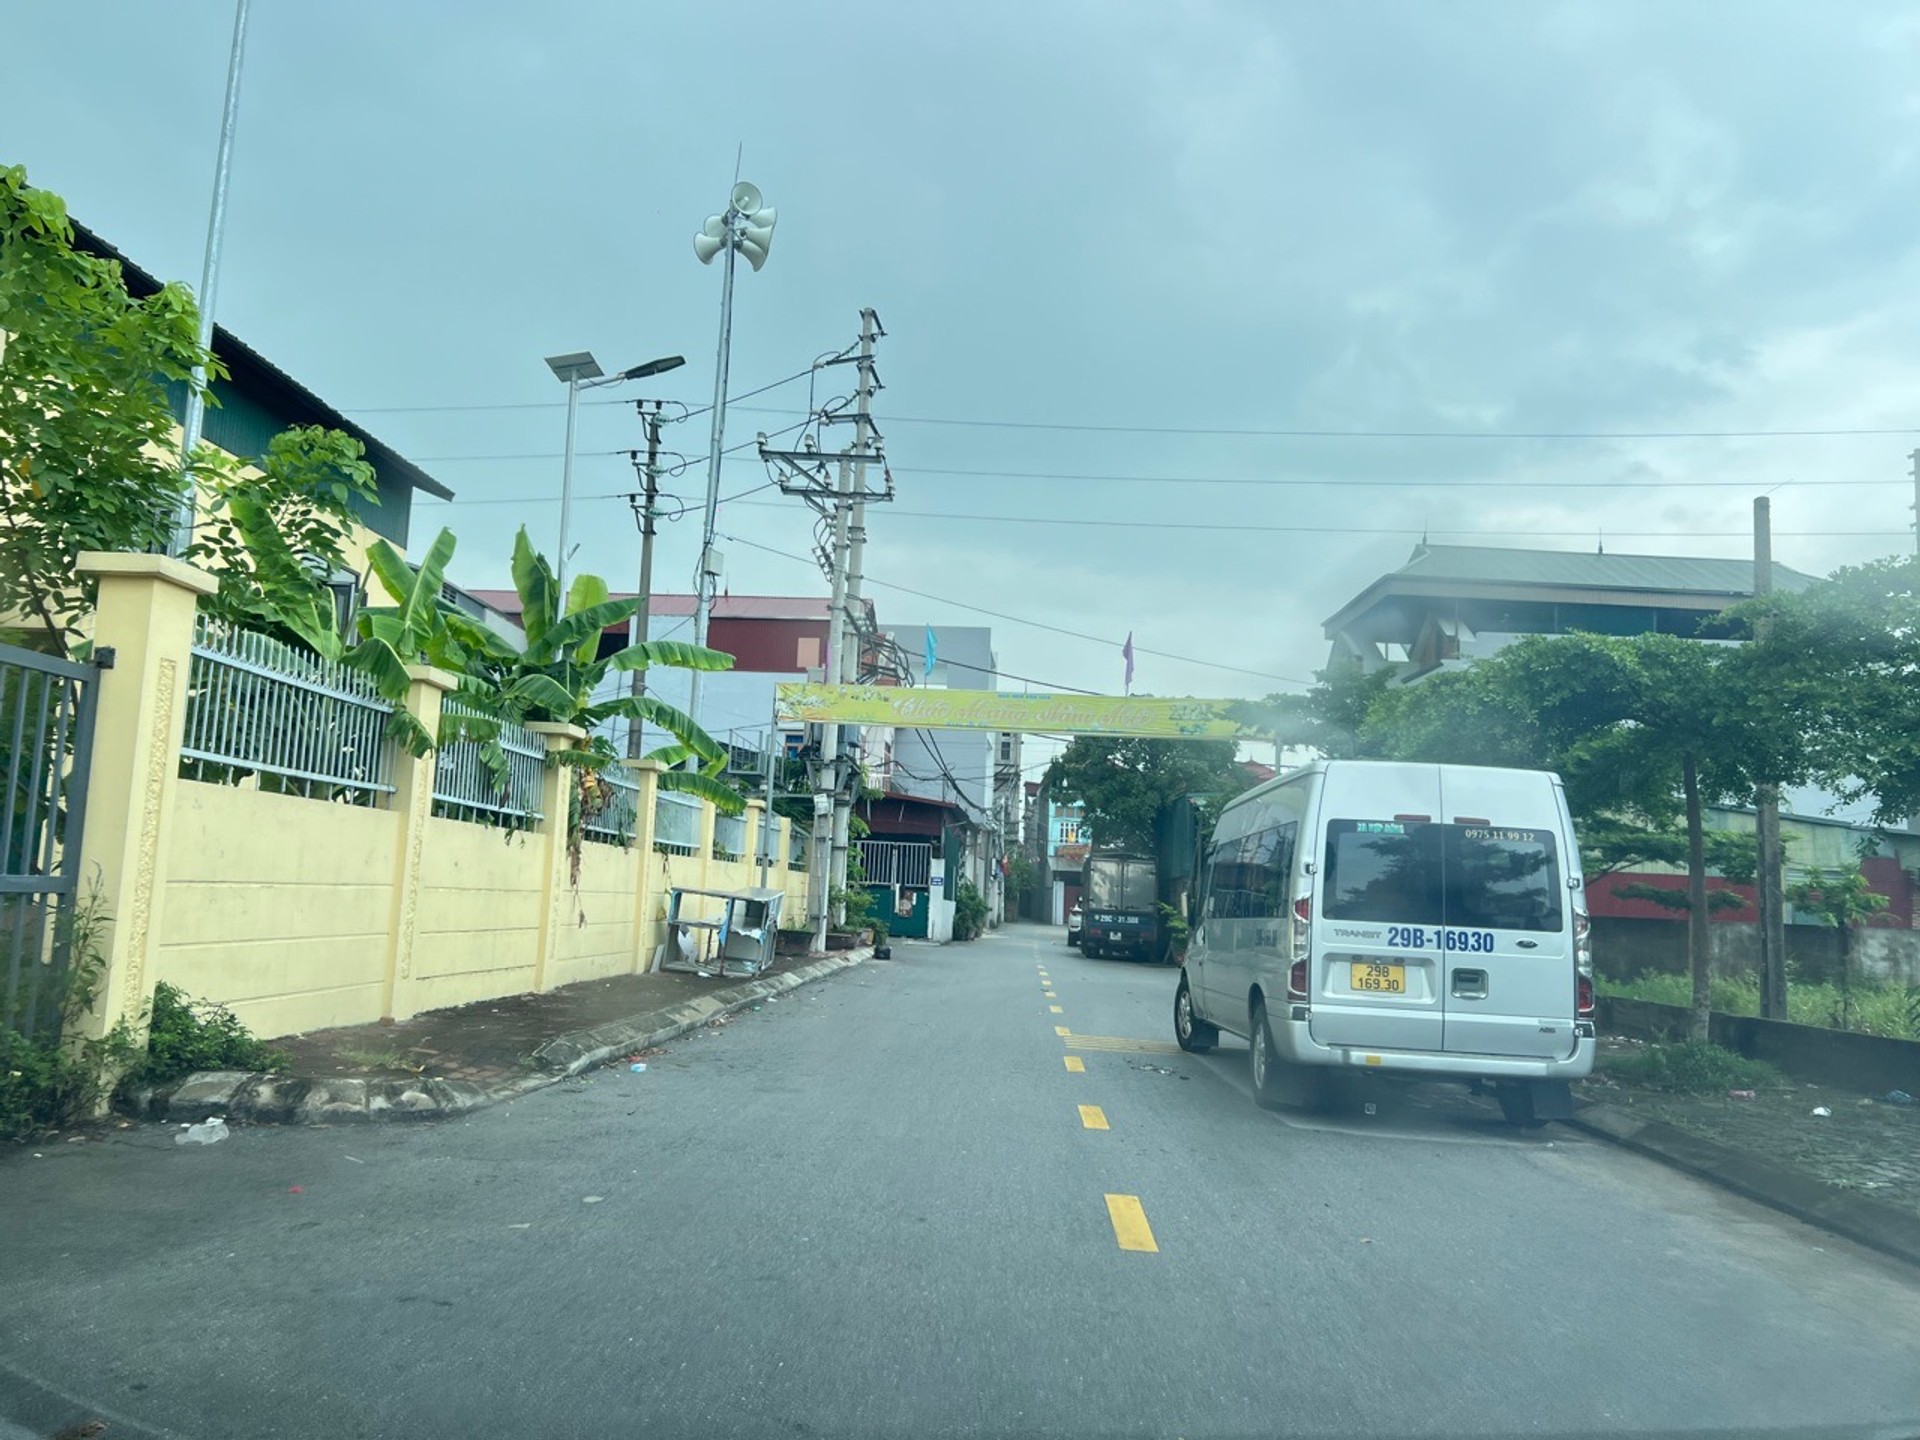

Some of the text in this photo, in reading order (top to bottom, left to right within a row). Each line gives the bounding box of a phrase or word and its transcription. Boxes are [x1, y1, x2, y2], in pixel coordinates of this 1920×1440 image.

[1465, 829, 1535, 842] 0975 11 99 12
[1334, 928, 1382, 939] TRANSIT
[1366, 965, 1390, 978] 29B
[1358, 977, 1399, 991] 169.30
